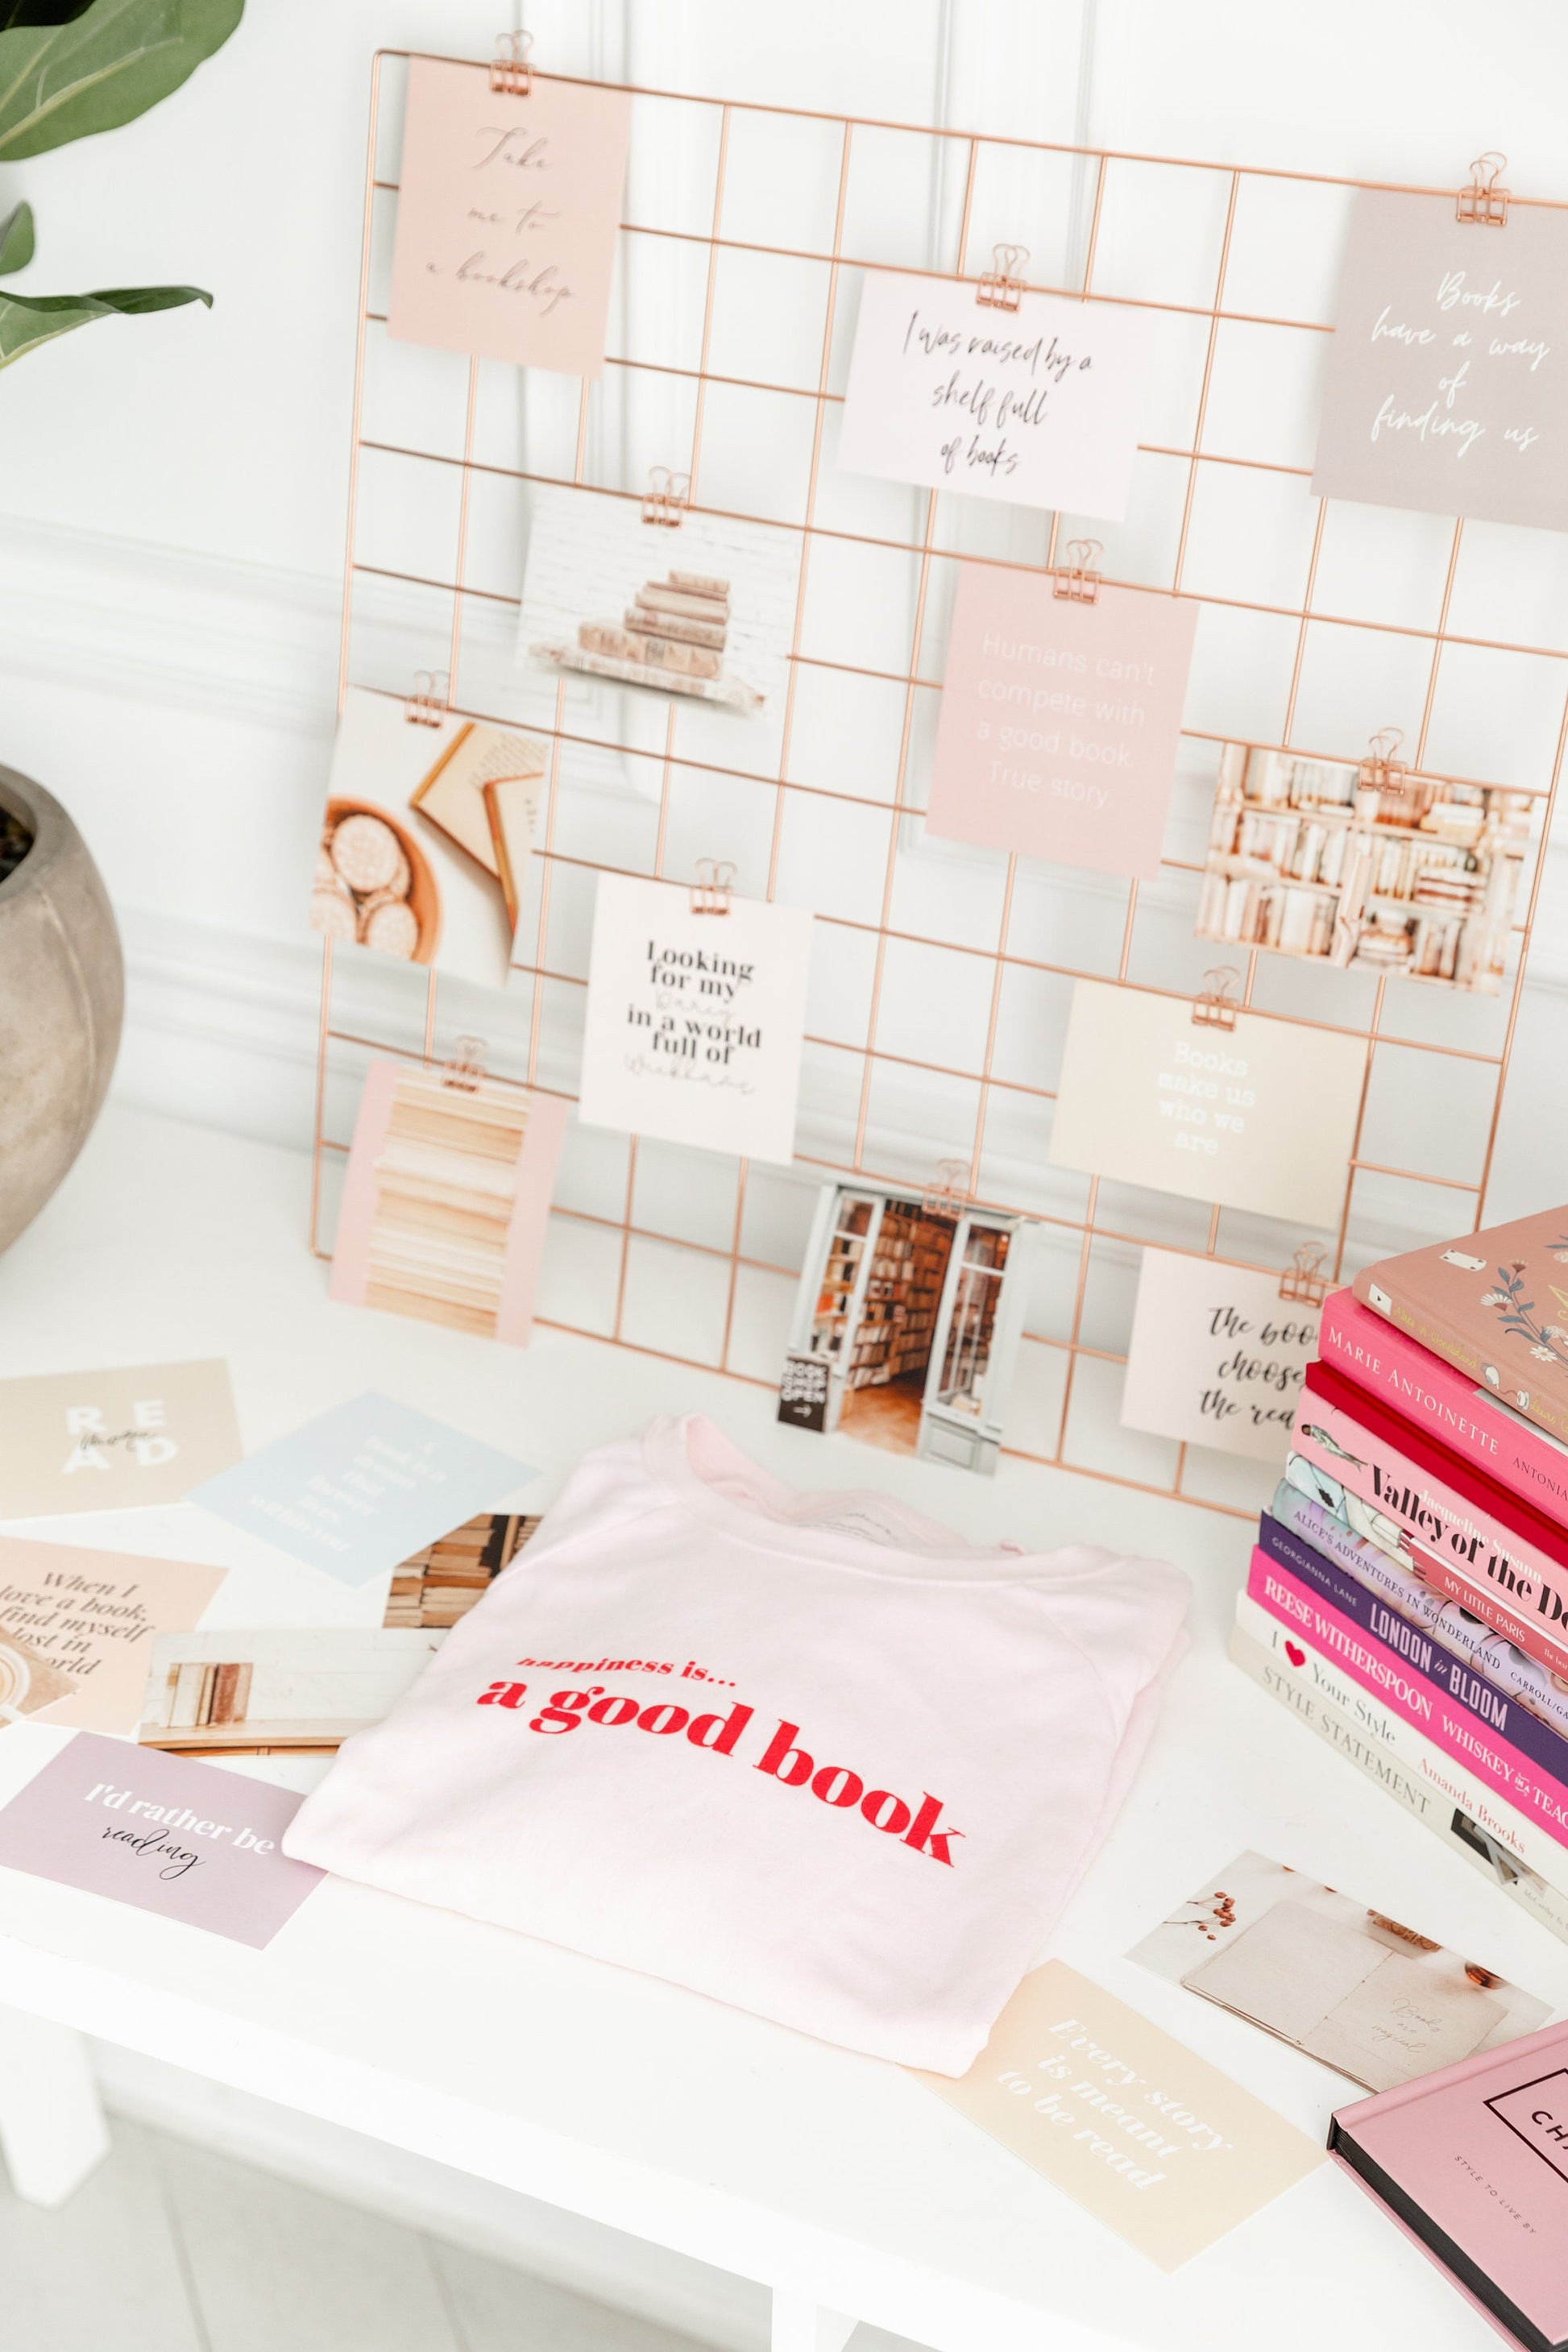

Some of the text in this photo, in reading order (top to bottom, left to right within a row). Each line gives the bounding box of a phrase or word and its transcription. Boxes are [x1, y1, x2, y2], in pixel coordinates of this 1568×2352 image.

[471, 126, 554, 170] Take
[467, 199, 562, 237] me to
[425, 249, 575, 319] a bookshop
[1437, 271, 1522, 318] Books
[902, 309, 1094, 384] I was raised by a
[1371, 304, 1551, 372] have a way
[931, 369, 1049, 429] shelf full
[1438, 360, 1471, 409] of
[1371, 393, 1541, 458] finding us
[940, 433, 1022, 477] of books
[982, 631, 1155, 686] Humans can't
[977, 679, 1146, 728] compete with
[977, 721, 990, 740] a
[999, 725, 1061, 753] good
[988, 760, 1041, 792] True
[647, 939, 756, 982] Looking
[651, 959, 741, 1004] for my
[628, 1002, 763, 1049] in a world
[652, 1031, 735, 1065] full of
[1174, 1039, 1249, 1077] Books
[1157, 1072, 1257, 1107] make us
[1158, 1098, 1245, 1135] who we
[1175, 1131, 1219, 1156] are
[1209, 1305, 1318, 1346] The boo
[1217, 1349, 1305, 1392] choose
[1328, 1325, 1499, 1457] MARIE ANTOINETTE
[1198, 1388, 1295, 1431] the rea
[1512, 1456, 1568, 1501] ANTONIA
[1372, 1463, 1449, 1543] Valley
[1450, 1531, 1485, 1566] of
[1487, 1552, 1533, 1603] the
[1417, 1488, 1544, 1584] Jacqueline Susann
[44, 1571, 140, 1599] When I
[1271, 1536, 1359, 1608] GEORGIANNA LANE
[56, 1599, 76, 1610] a
[1335, 1540, 1405, 1599] ADVENTURES
[1406, 1593, 1421, 1612] IN
[1423, 1603, 1502, 1670] WONDERLAND
[1445, 1576, 1527, 1643] MY LITTLE PARIS
[12, 1627, 92, 1653] lost in
[60, 1618, 156, 1644] myself
[1263, 1574, 1434, 1722] REESE WITHERSPOON
[45, 1657, 102, 1675] orld
[516, 1656, 737, 1688] happiness is...
[1370, 1602, 1509, 1732] LONDON in BLOOM
[1310, 1661, 1351, 1708] Your
[1354, 1698, 1397, 1747] Style
[1509, 1670, 1568, 1719] CARROLL/GA
[1261, 1662, 1432, 1815] STYLE STATEMENT
[475, 1679, 966, 1868] a good book
[1441, 1713, 1515, 1782] WHISKEY
[1533, 1786, 1568, 1831] TEAC
[84, 1783, 276, 1856] I'd rather be
[1418, 1757, 1526, 1854] Amanda Brooks
[101, 1825, 206, 1881] reading
[1047, 2018, 1147, 2086] Every
[996, 2071, 1168, 2191] to be read
[1038, 2055, 1184, 2160] is meant
[1531, 2110, 1568, 2151] CH
[1454, 2155, 1537, 2235] STYLE TO LIVE BY
